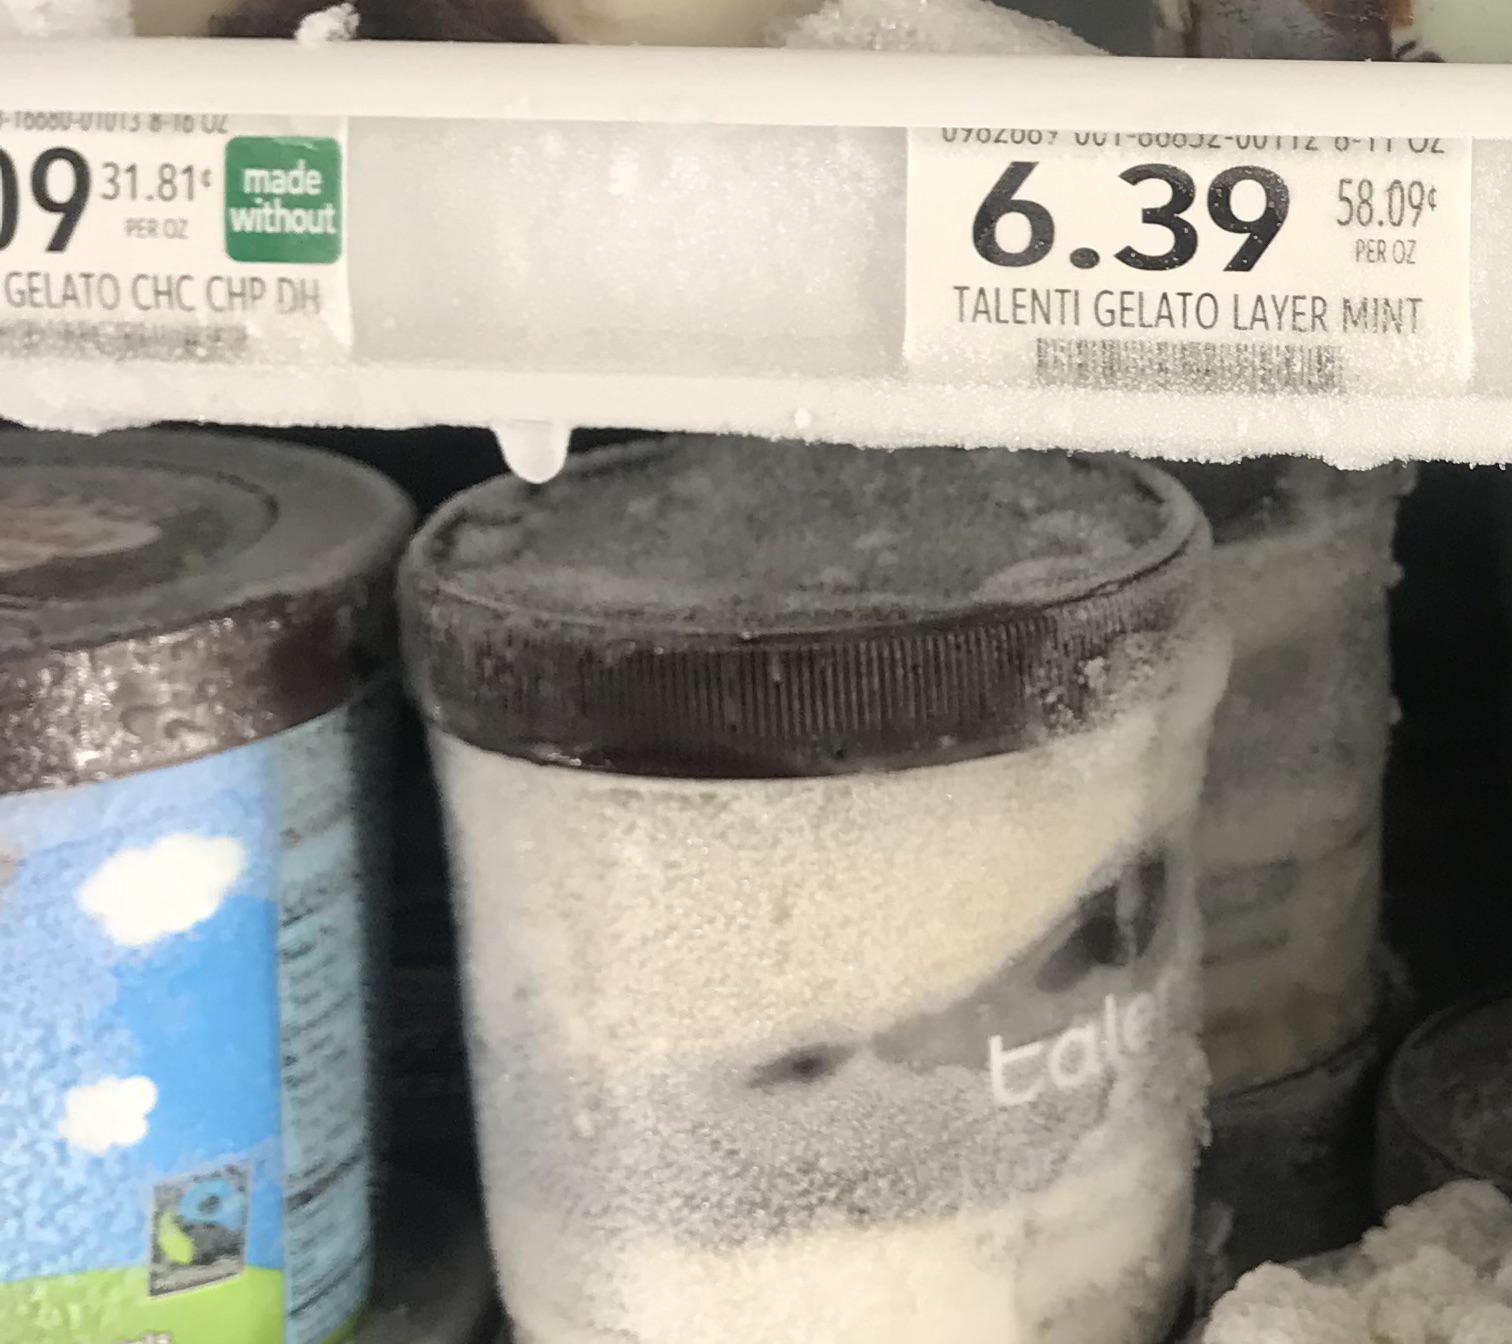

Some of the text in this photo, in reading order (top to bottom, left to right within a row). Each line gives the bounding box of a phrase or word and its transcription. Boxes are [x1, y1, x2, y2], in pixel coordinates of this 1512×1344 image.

[243, 159, 322, 196] made
[231, 198, 336, 234] without
[972, 160, 1290, 272] 6.39
[1355, 239, 1418, 265] PER OZ
[4, 270, 320, 314] GELATO CHC CHP DH
[953, 285, 1424, 335] TALENTI GELATO LAYER MINT
